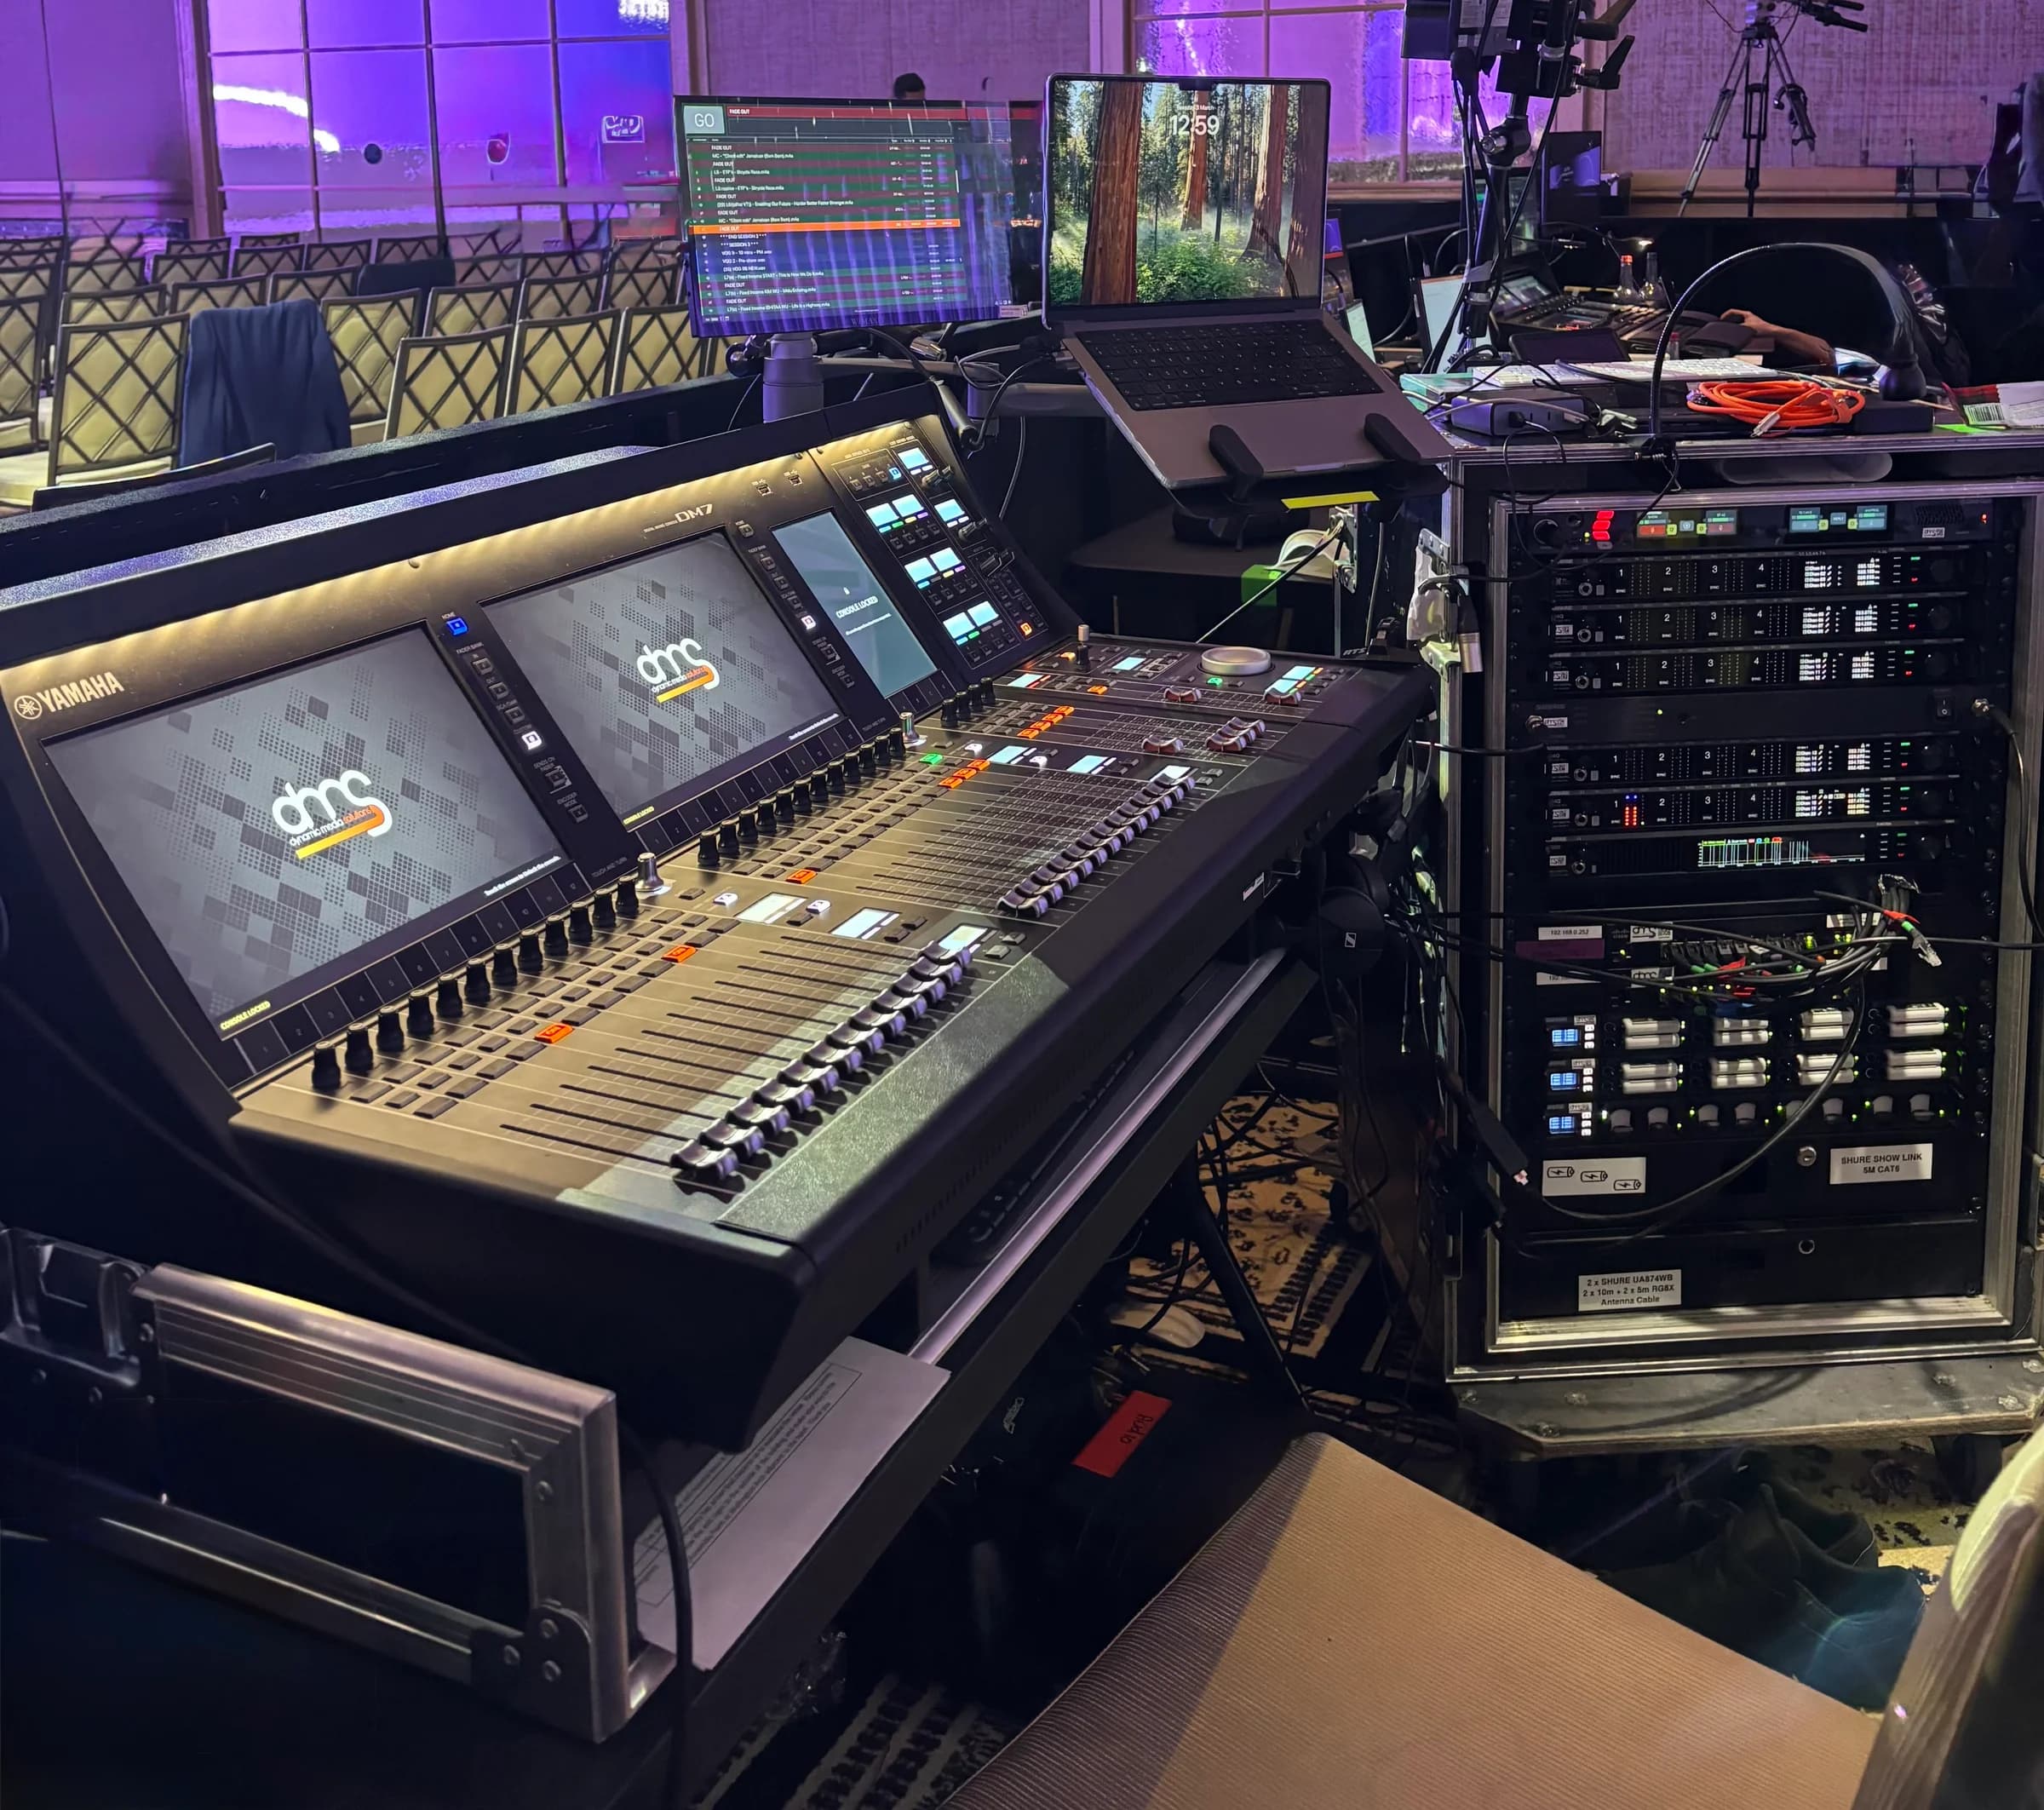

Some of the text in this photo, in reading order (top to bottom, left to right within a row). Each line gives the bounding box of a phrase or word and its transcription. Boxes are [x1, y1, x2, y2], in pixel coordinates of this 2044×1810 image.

[694, 112, 715, 128] GO
[1170, 114, 1220, 135] 12:59
[675, 503, 713, 522] DM7
[1618, 563, 1765, 577] 1 2 3 4
[836, 595, 879, 619] CONSOLE LOCKED
[1663, 613, 1670, 622] 2
[1710, 612, 1717, 620] 3
[637, 638, 720, 690] dms
[1708, 658, 1714, 667] 3
[36, 671, 124, 712] YAMAHA
[1613, 755, 1617, 763] 1
[1659, 753, 1665, 761] 2
[1750, 749, 1756, 757] 4
[273, 770, 393, 837] dms
[1614, 800, 1618, 808] 1
[1659, 798, 1665, 807] 2
[221, 1001, 271, 1031] CONSOLE LOCKED
[1841, 1152, 1922, 1164] SHURE SHOW LINK
[1601, 1276, 1630, 1286] SHURE
[1633, 1273, 1674, 1284] UA874WB
[1601, 1296, 1660, 1306] Antenna Cable
